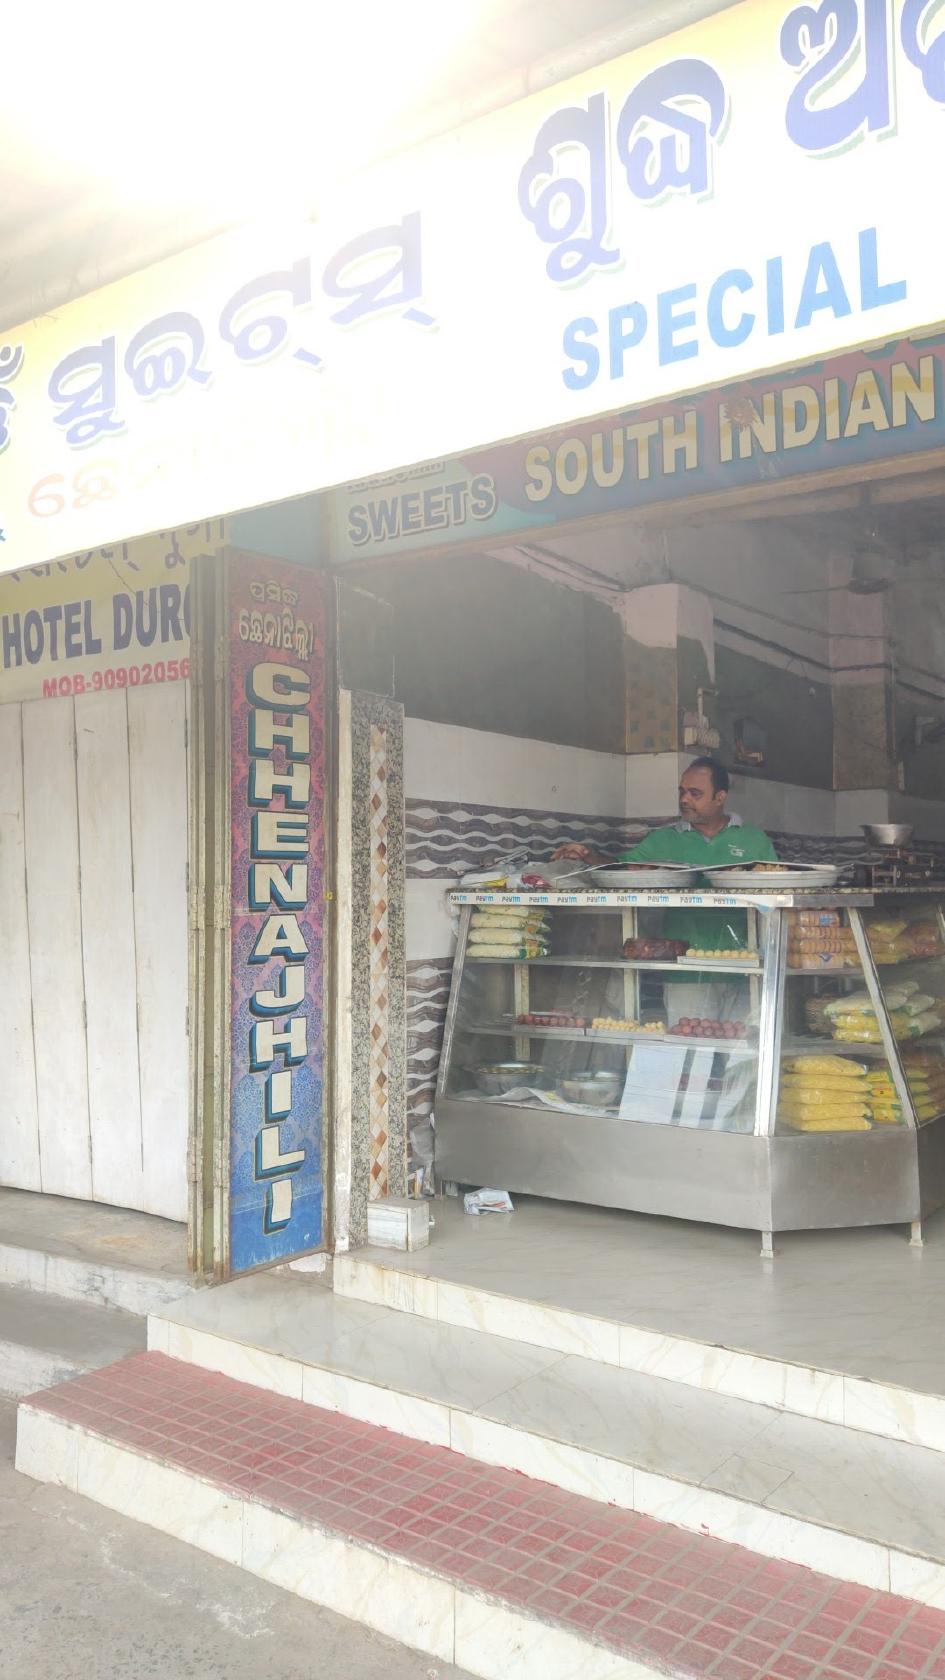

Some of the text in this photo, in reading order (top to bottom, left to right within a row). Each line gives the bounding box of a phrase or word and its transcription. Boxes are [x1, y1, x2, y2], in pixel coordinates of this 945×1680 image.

[518, 58, 729, 286] ଶୁଦ୍ଧ
[562, 227, 907, 390] SPECIAL
[523, 354, 936, 503] SOUTH INDIAN
[348, 473, 496, 546] SWEETS
[3, 599, 101, 669] HOTEL
[246, 661, 311, 1230] CHHENAJHILI
